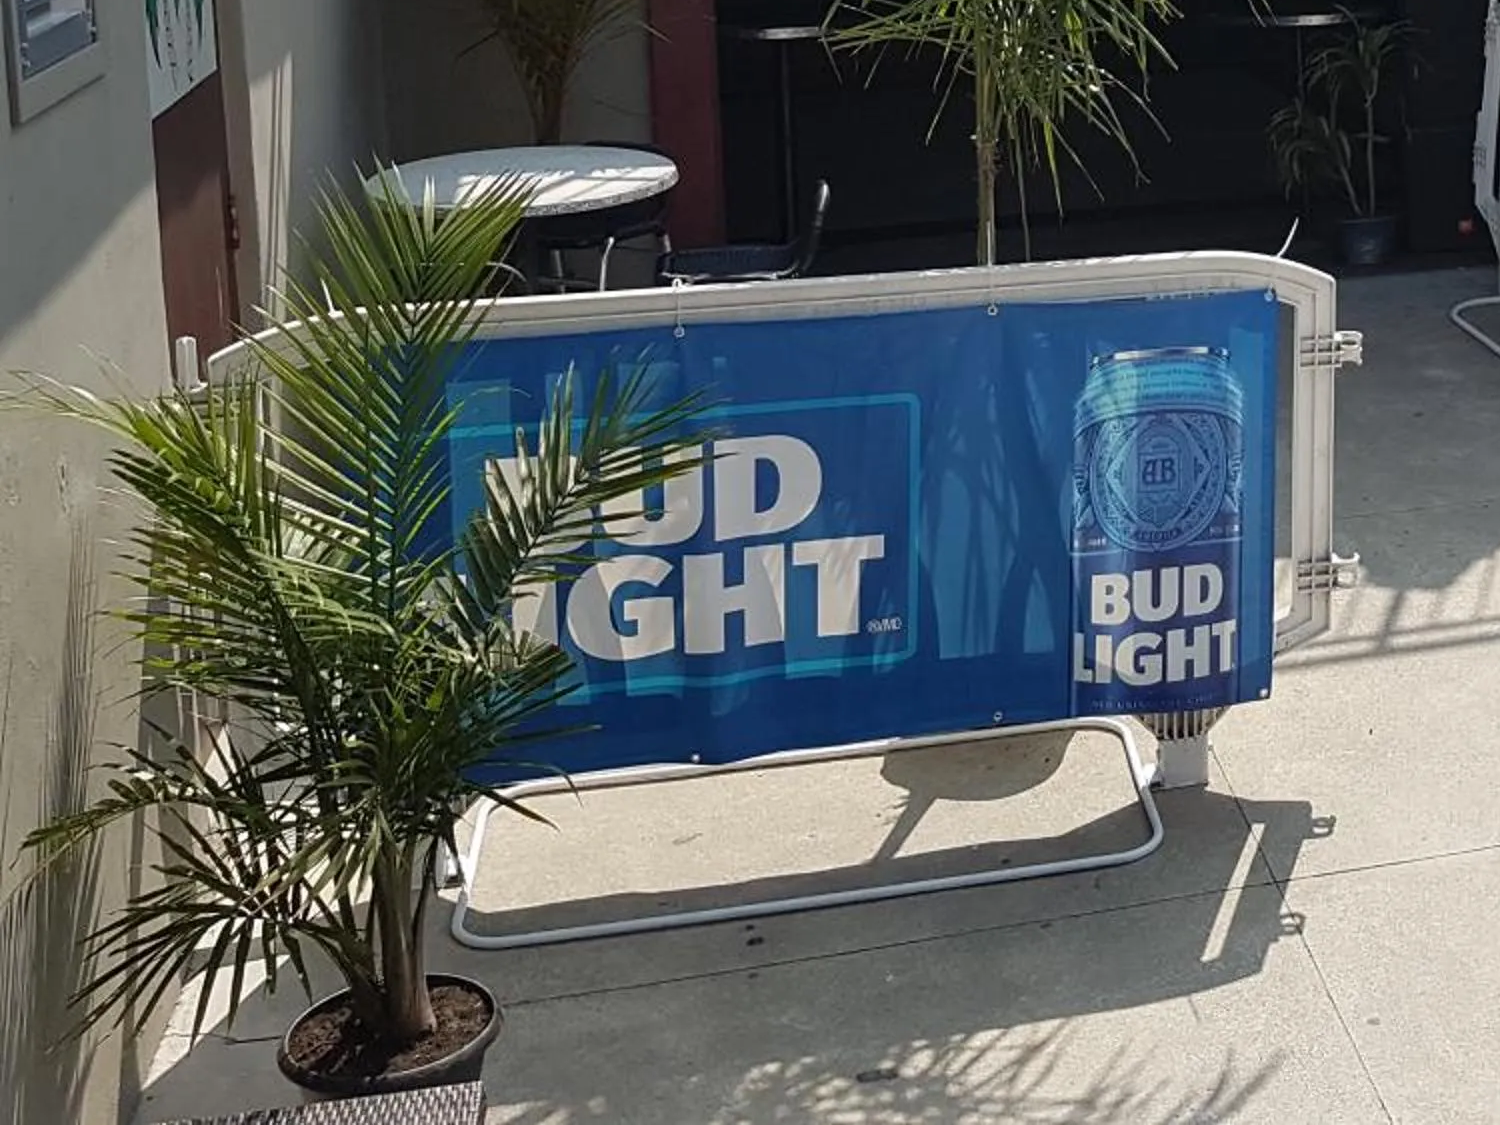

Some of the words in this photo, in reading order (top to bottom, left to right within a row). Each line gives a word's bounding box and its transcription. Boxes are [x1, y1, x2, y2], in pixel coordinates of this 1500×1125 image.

[445, 534, 885, 661] IGHT
[1091, 562, 1224, 625] BUD
[1073, 618, 1237, 686] LIGHT
